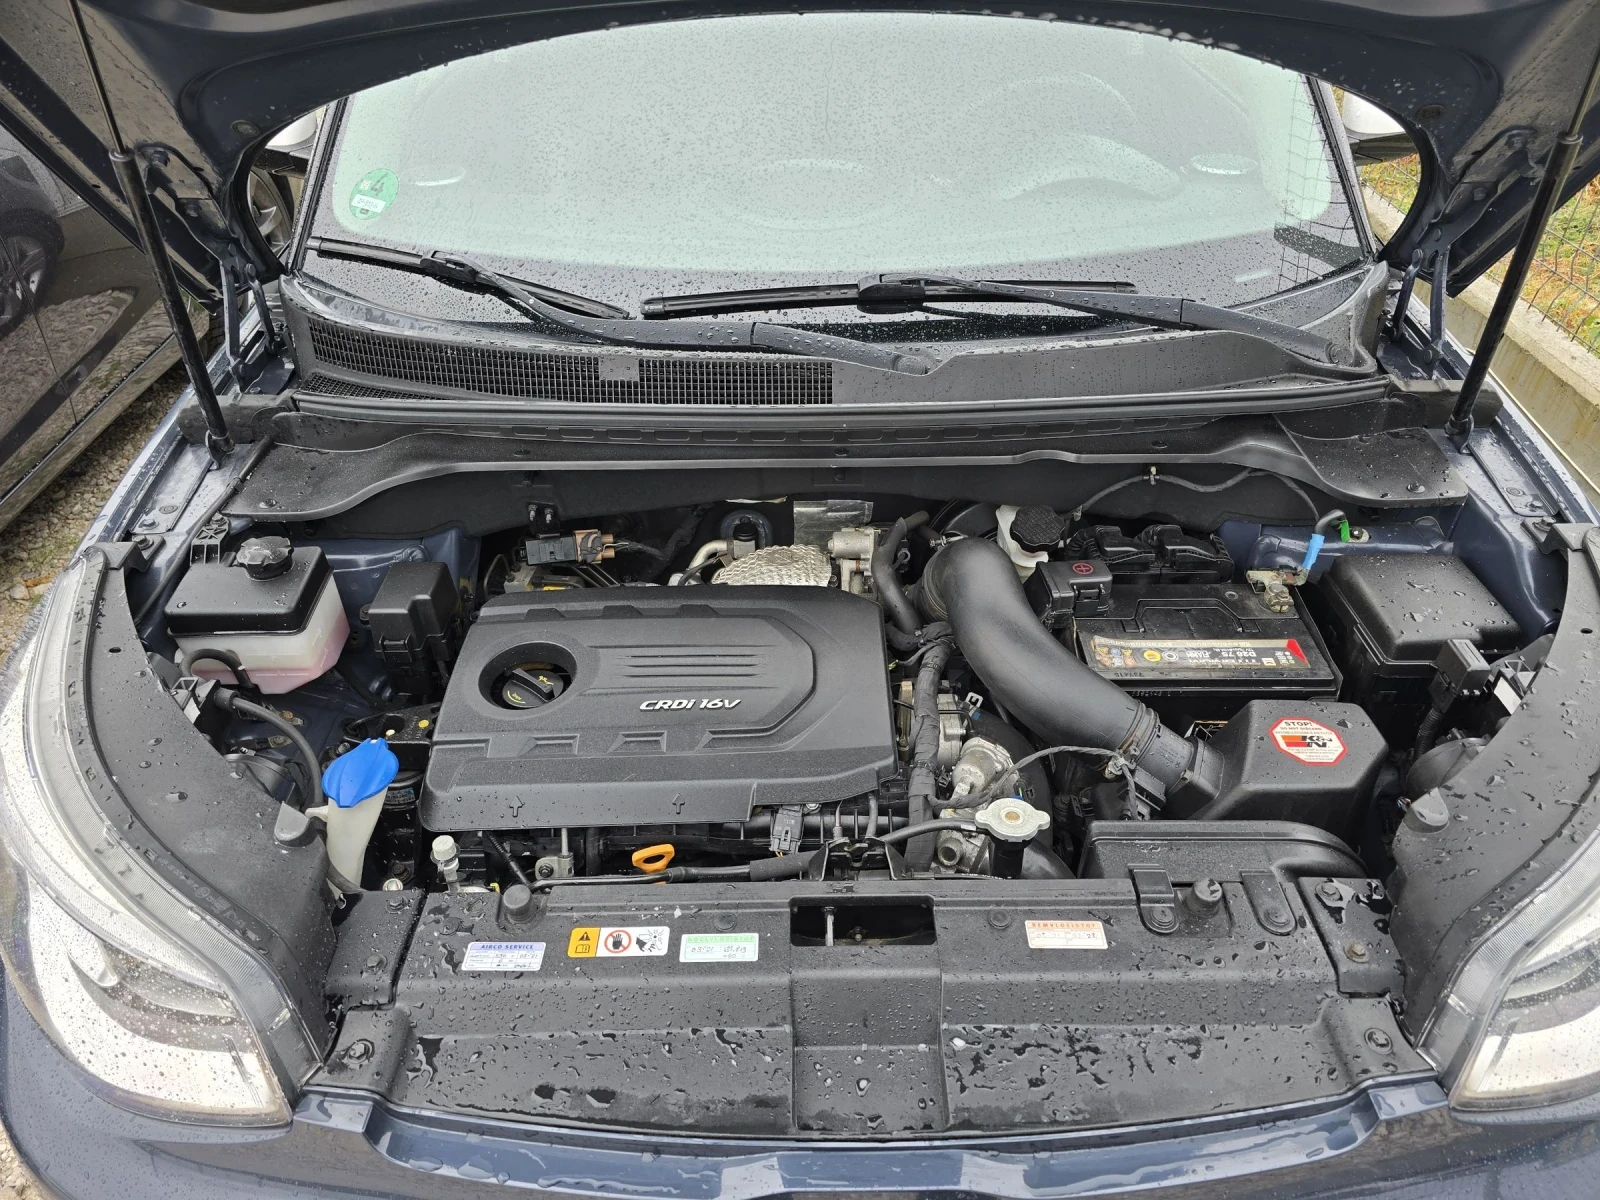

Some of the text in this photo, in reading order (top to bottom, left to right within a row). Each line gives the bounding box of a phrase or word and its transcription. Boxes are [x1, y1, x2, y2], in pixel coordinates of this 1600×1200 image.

[371, 172, 389, 197] 4
[639, 698, 742, 711] CRDi 16V
[1301, 735, 1333, 748] K&N
